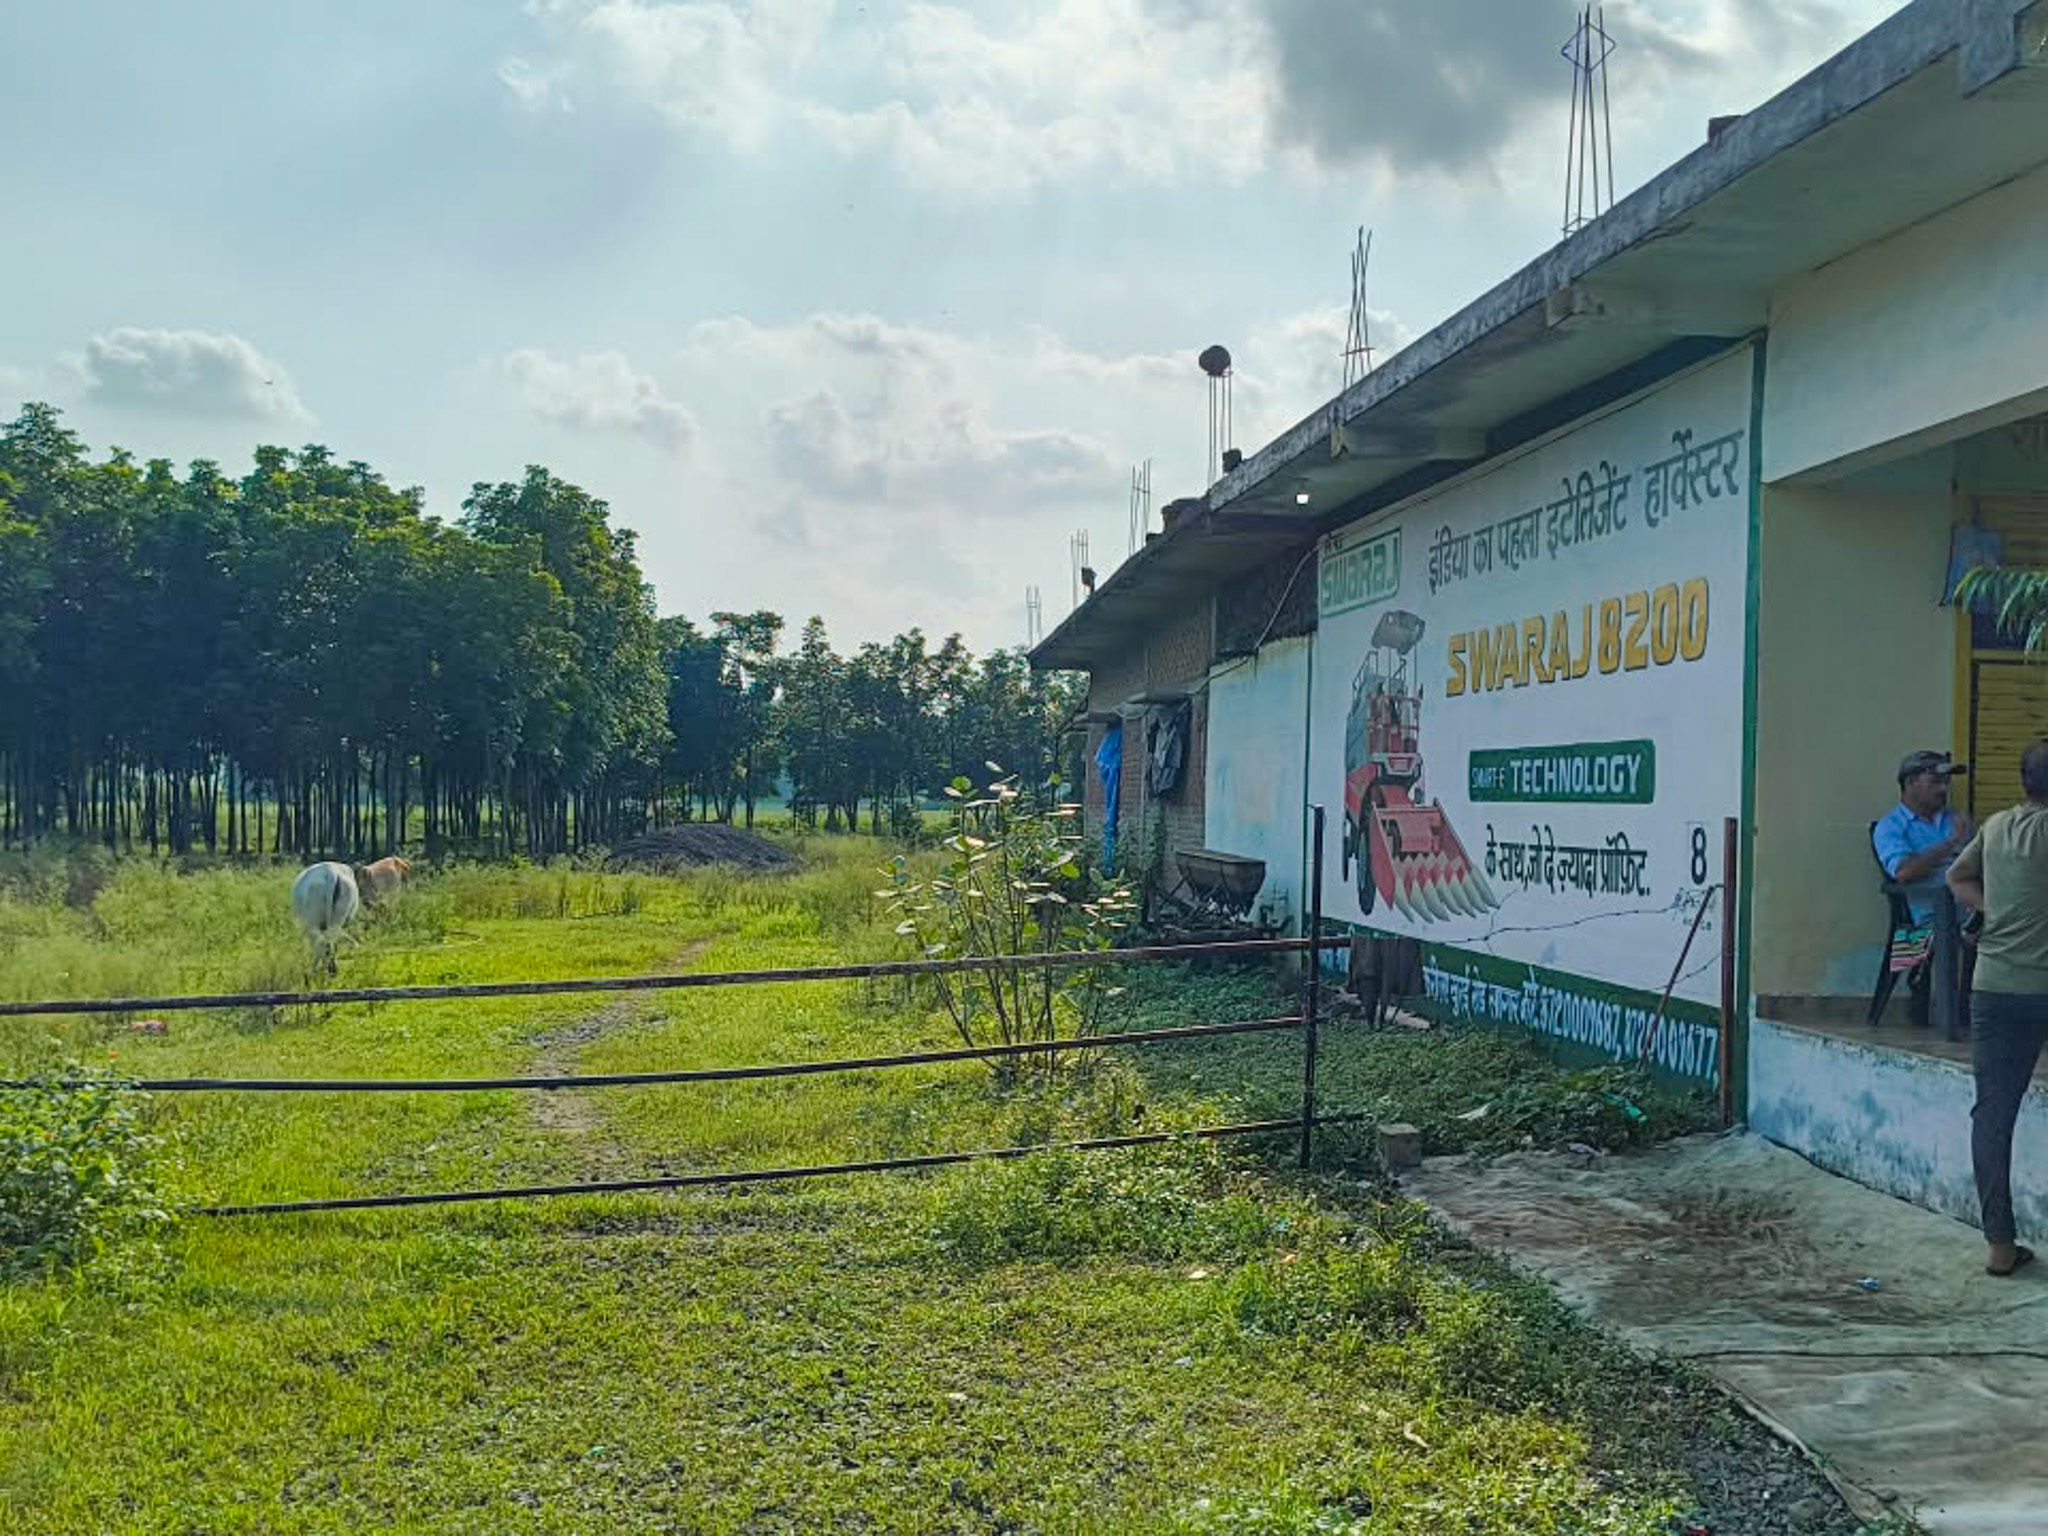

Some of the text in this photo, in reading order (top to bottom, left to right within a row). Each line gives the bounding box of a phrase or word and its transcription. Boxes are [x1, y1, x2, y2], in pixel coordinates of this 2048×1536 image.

[1429, 525, 1469, 595] इंडिया
[1473, 524, 1493, 574] का
[1496, 507, 1543, 571] पहला
[1446, 576, 1709, 697] SWARAJ 8200
[1510, 753, 1641, 795] TECHNOLOGY
[1484, 823, 1498, 878] के
[1544, 824, 1556, 894] दे
[1691, 827, 1707, 886] 8
